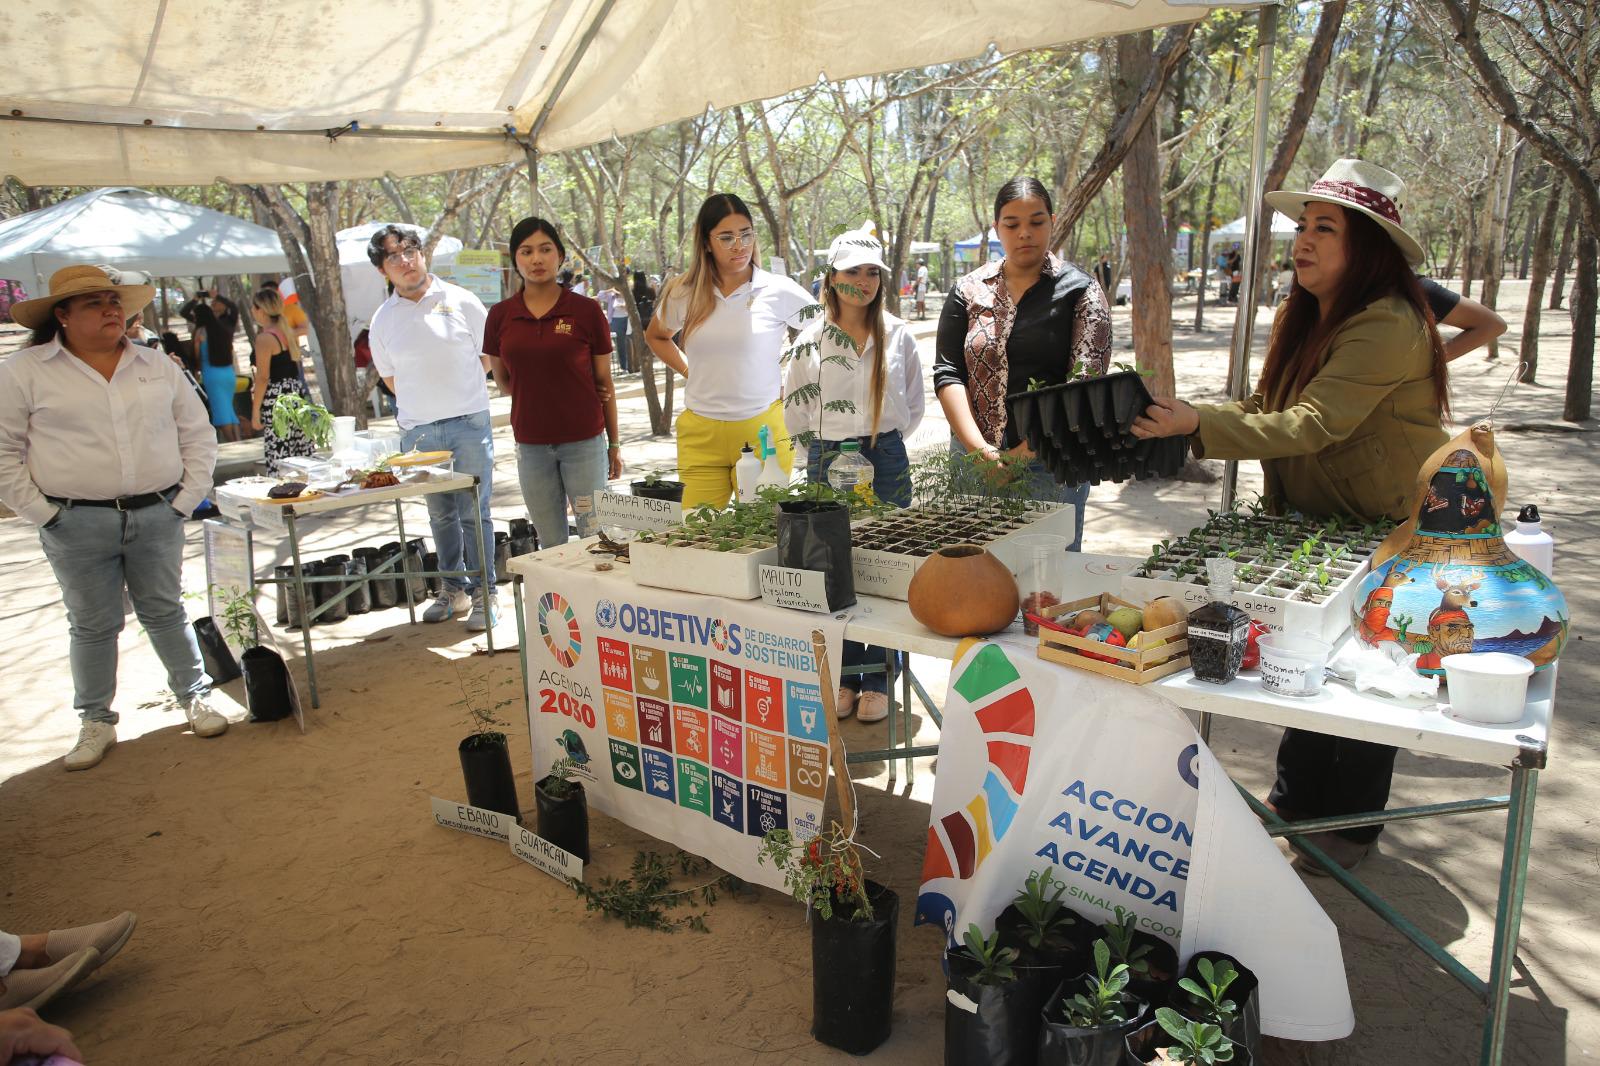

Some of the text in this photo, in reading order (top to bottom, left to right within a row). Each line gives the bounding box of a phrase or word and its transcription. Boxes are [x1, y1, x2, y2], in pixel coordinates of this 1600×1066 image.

[601, 492, 672, 514] AMAPA ROSA
[761, 568, 802, 587] MAUTO
[618, 603, 742, 656] OBJETIVOS
[600, 641, 606, 653] 1
[744, 627, 813, 653] DE DESARROL
[635, 648, 641, 660] 2
[744, 643, 818, 673] SOSTENIBL
[672, 656, 678, 668] 3
[713, 664, 718, 677] 4
[538, 669, 593, 701] AGENDA
[748, 675, 754, 688] 5
[790, 685, 796, 699] 6
[539, 688, 596, 729] 2030
[639, 701, 645, 713] 8
[676, 709, 682, 721] 9
[714, 718, 722, 732] 10
[750, 731, 758, 744] 11
[610, 742, 620, 754] 13
[791, 743, 802, 757] 12
[644, 752, 654, 764] 14
[680, 762, 690, 775] 15
[713, 774, 723, 788] 16
[750, 788, 761, 801] 17
[457, 806, 499, 829] EBANO
[1047, 811, 1191, 881] AVANCE
[1034, 841, 1178, 912] AGENDA
[1068, 886, 1138, 919] SINALOA
